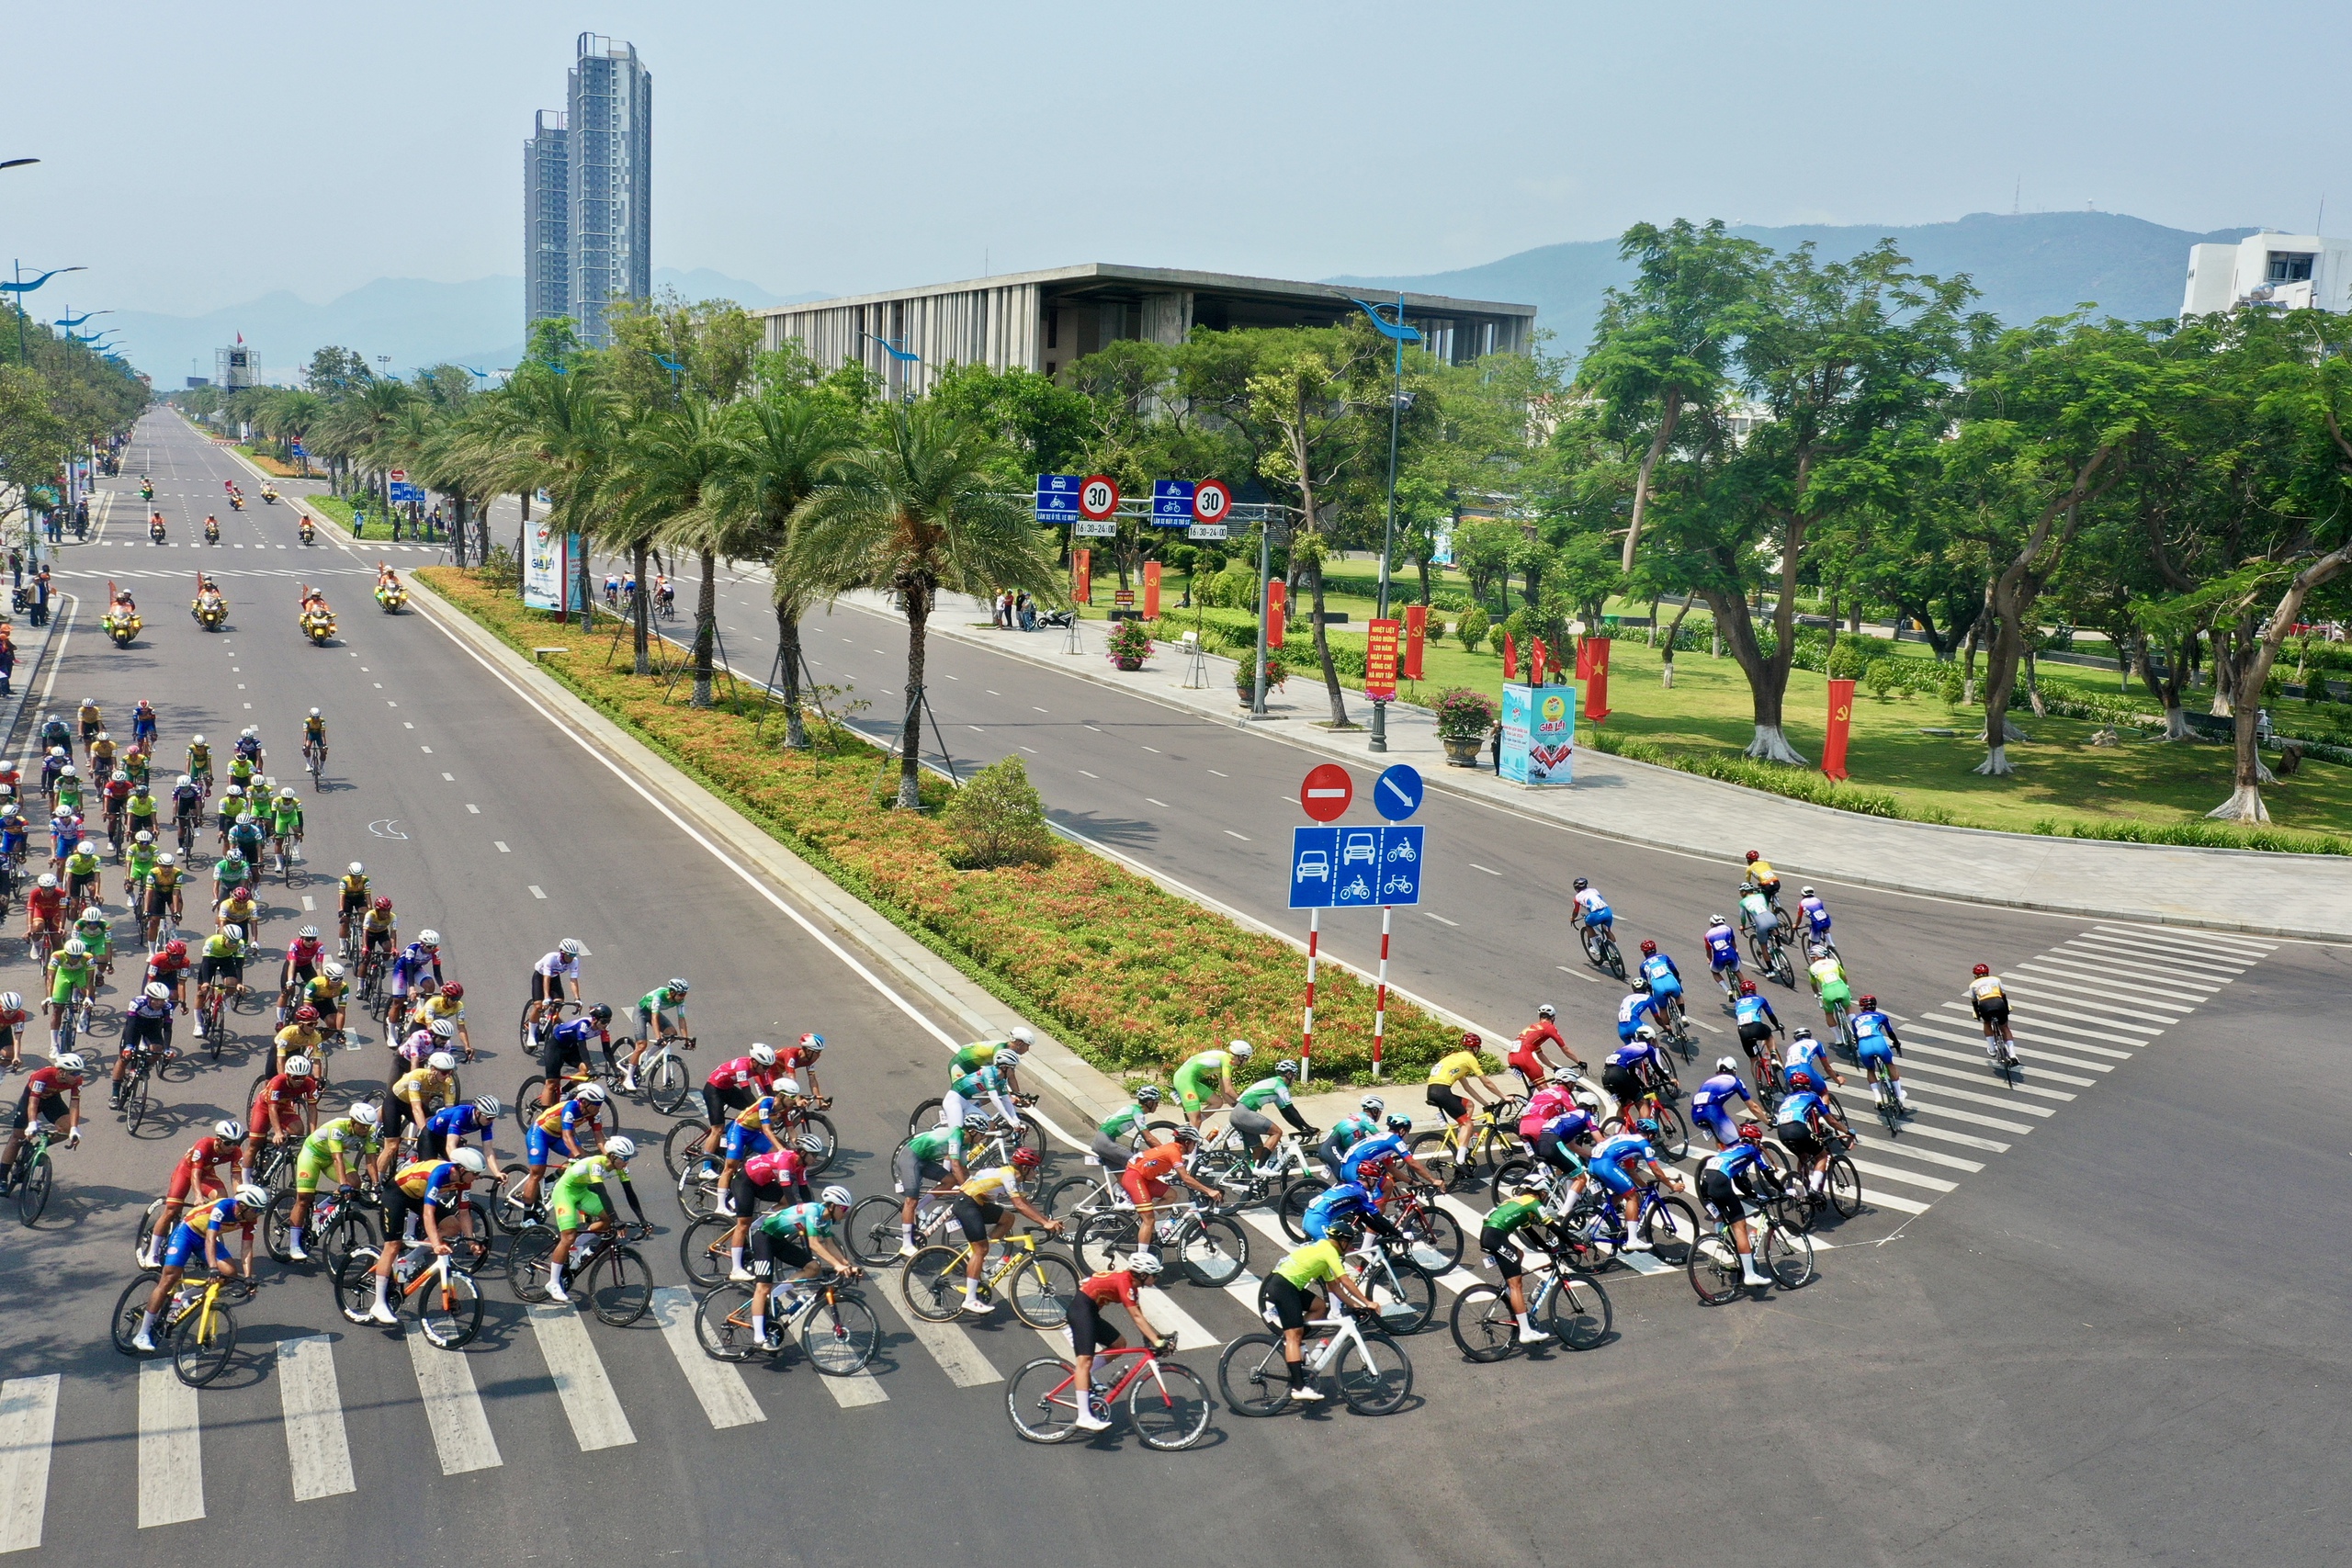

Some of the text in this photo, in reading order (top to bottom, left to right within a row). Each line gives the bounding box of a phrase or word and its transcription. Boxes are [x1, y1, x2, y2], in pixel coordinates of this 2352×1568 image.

[1089, 488, 1106, 506] 30
[1202, 492, 1218, 511] 30
[1077, 524, 1115, 533] 16:30-24:00
[1190, 527, 1227, 536] 16:30-24:00
[1539, 722, 1553, 732] GIA
[316, 1203, 341, 1236] FACTOR
[926, 1204, 954, 1235] FACTO
[1160, 1218, 1186, 1245] COLNAGO
